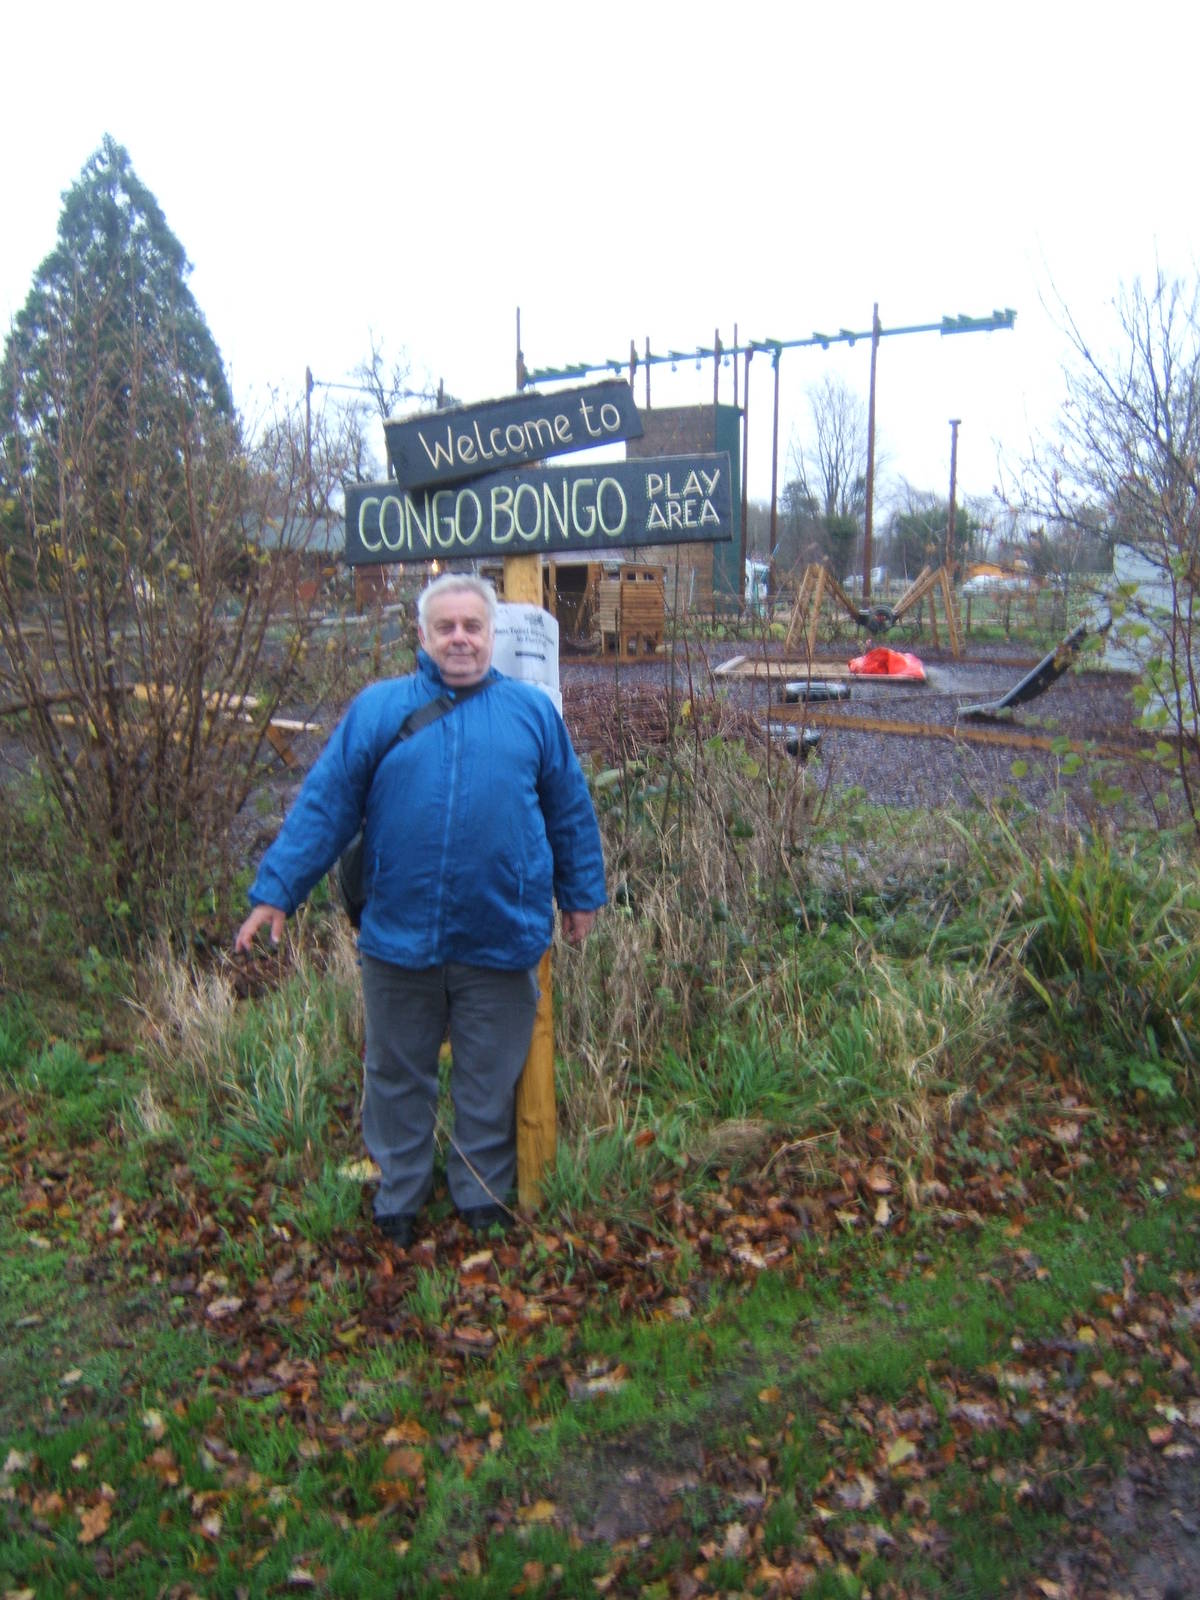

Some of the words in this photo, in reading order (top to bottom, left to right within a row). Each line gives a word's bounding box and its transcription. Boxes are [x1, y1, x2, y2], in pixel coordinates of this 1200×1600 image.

[417, 413, 573, 470] Welcome
[579, 397, 621, 438] to
[647, 468, 721, 499] PLAY
[358, 488, 483, 552] CONGO
[490, 475, 628, 544] BONGO
[647, 498, 721, 531] AREA
